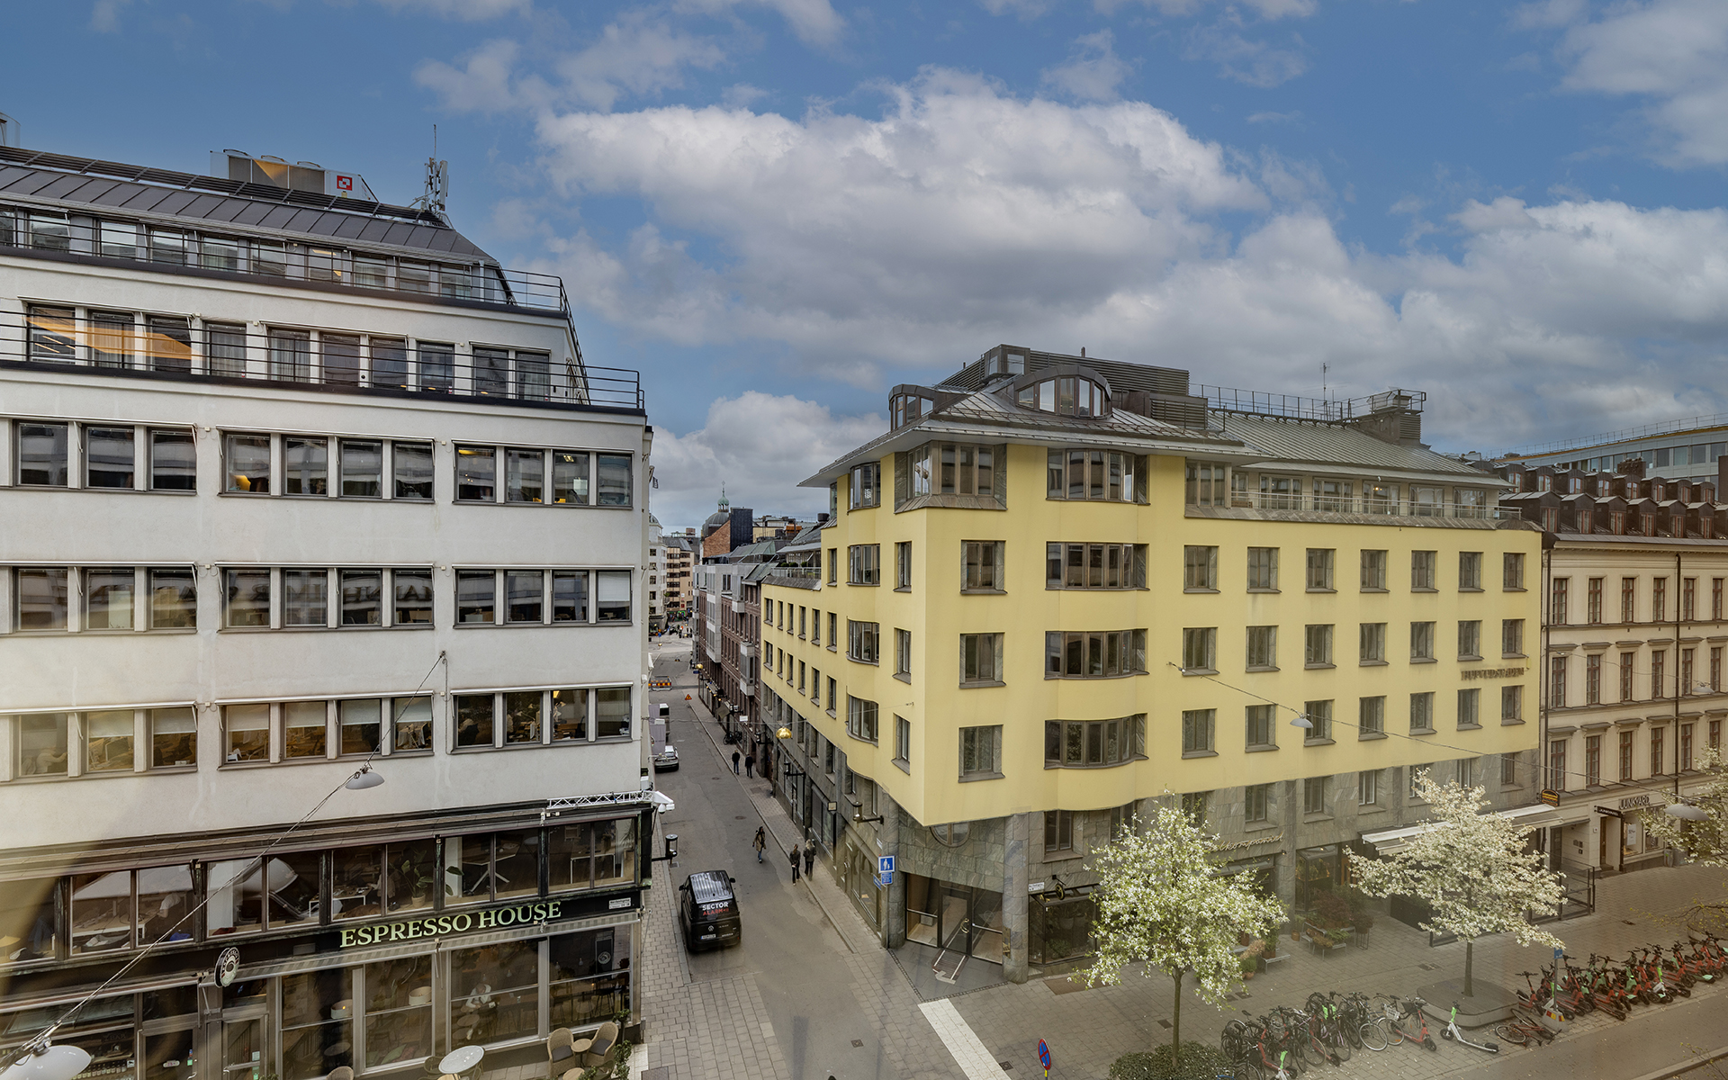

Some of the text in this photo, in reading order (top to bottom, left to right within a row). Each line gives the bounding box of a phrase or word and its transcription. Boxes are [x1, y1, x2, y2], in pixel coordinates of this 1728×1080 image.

[1619, 794, 1650, 810] JUNKYARD
[702, 902, 728, 911] SECTOR
[339, 901, 561, 948] ESPRESSO HOUSE
